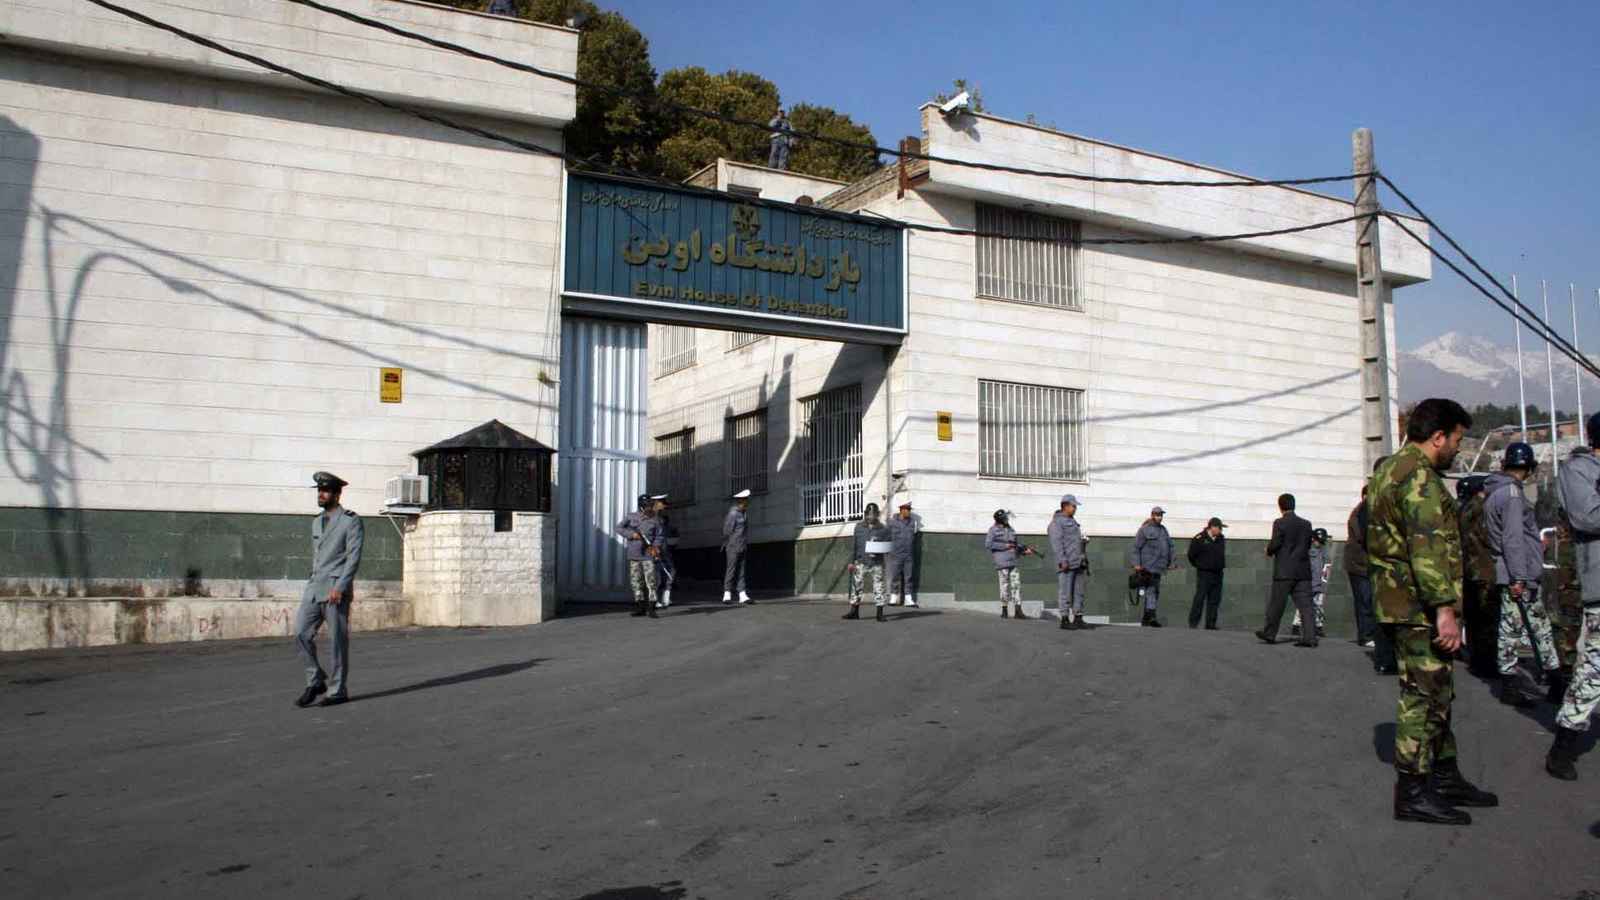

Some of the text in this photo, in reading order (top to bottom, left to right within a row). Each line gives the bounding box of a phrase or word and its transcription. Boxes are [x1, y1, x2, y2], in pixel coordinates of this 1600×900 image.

[624, 229, 861, 294] بازداشتگاه اوین
[634, 279, 675, 298] Evin
[680, 288, 738, 304] House
